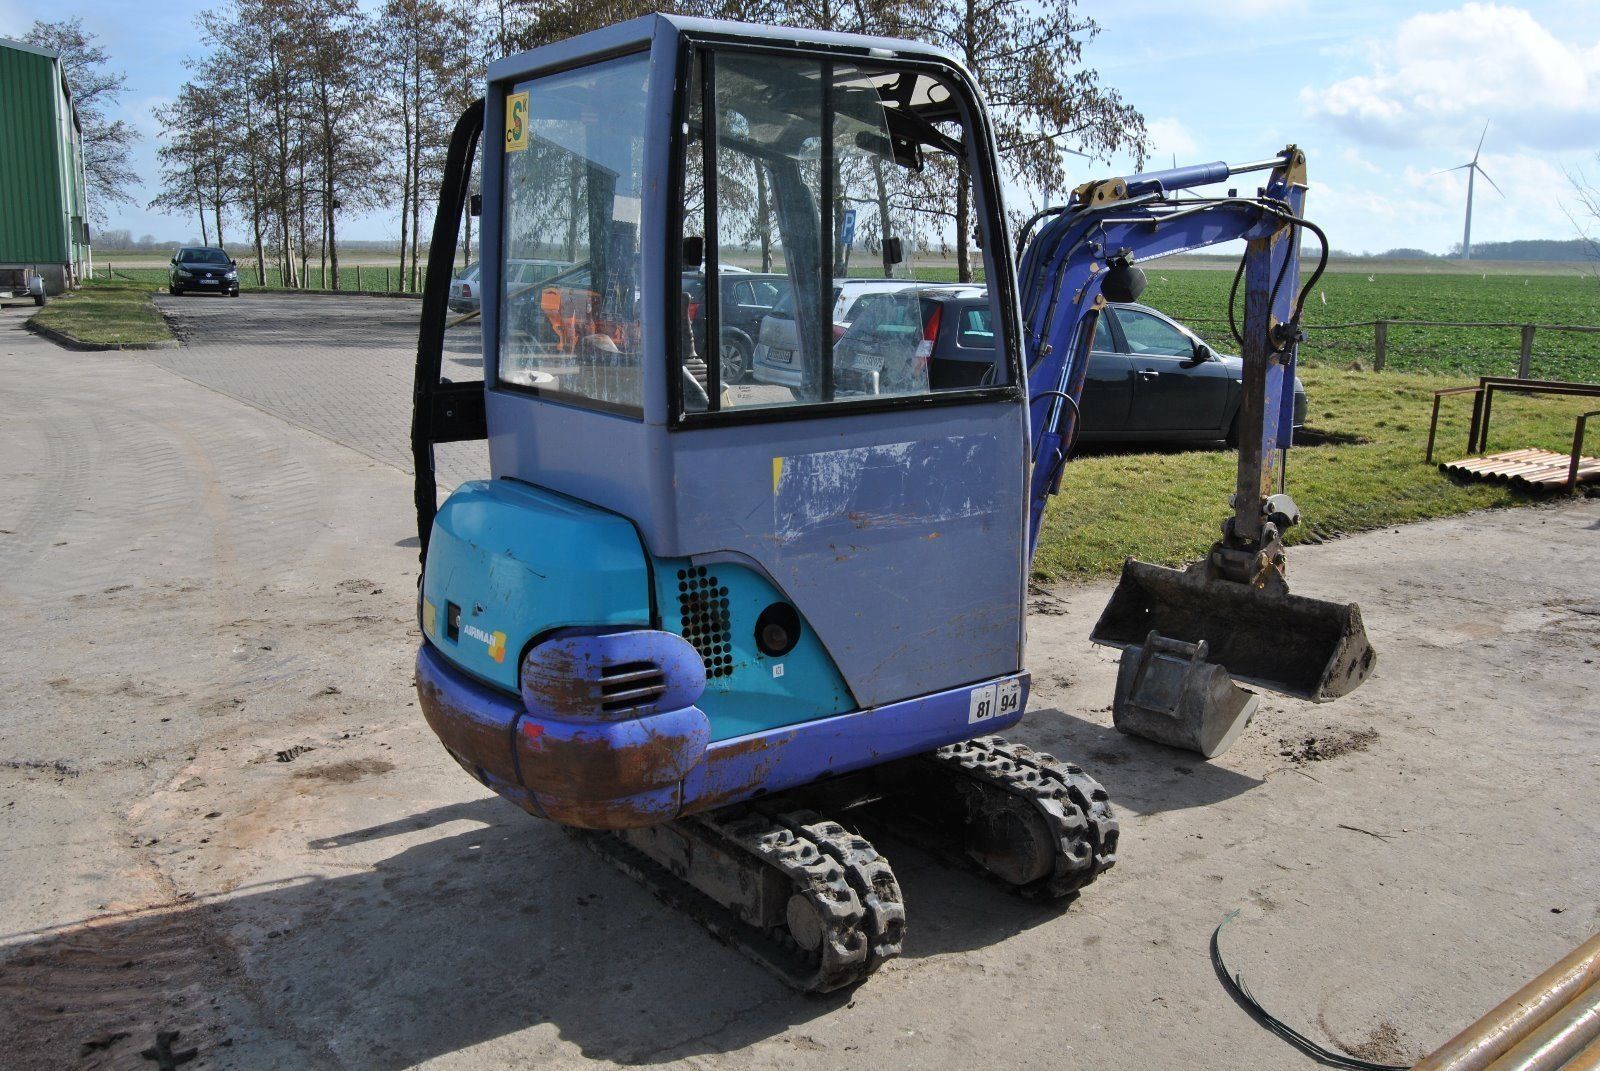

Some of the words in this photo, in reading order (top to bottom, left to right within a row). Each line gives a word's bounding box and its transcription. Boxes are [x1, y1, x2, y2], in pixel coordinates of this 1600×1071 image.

[843, 212, 854, 237] P
[464, 624, 496, 647] AIRMAN
[977, 700, 990, 718] 81
[1001, 693, 1017, 711] 94
